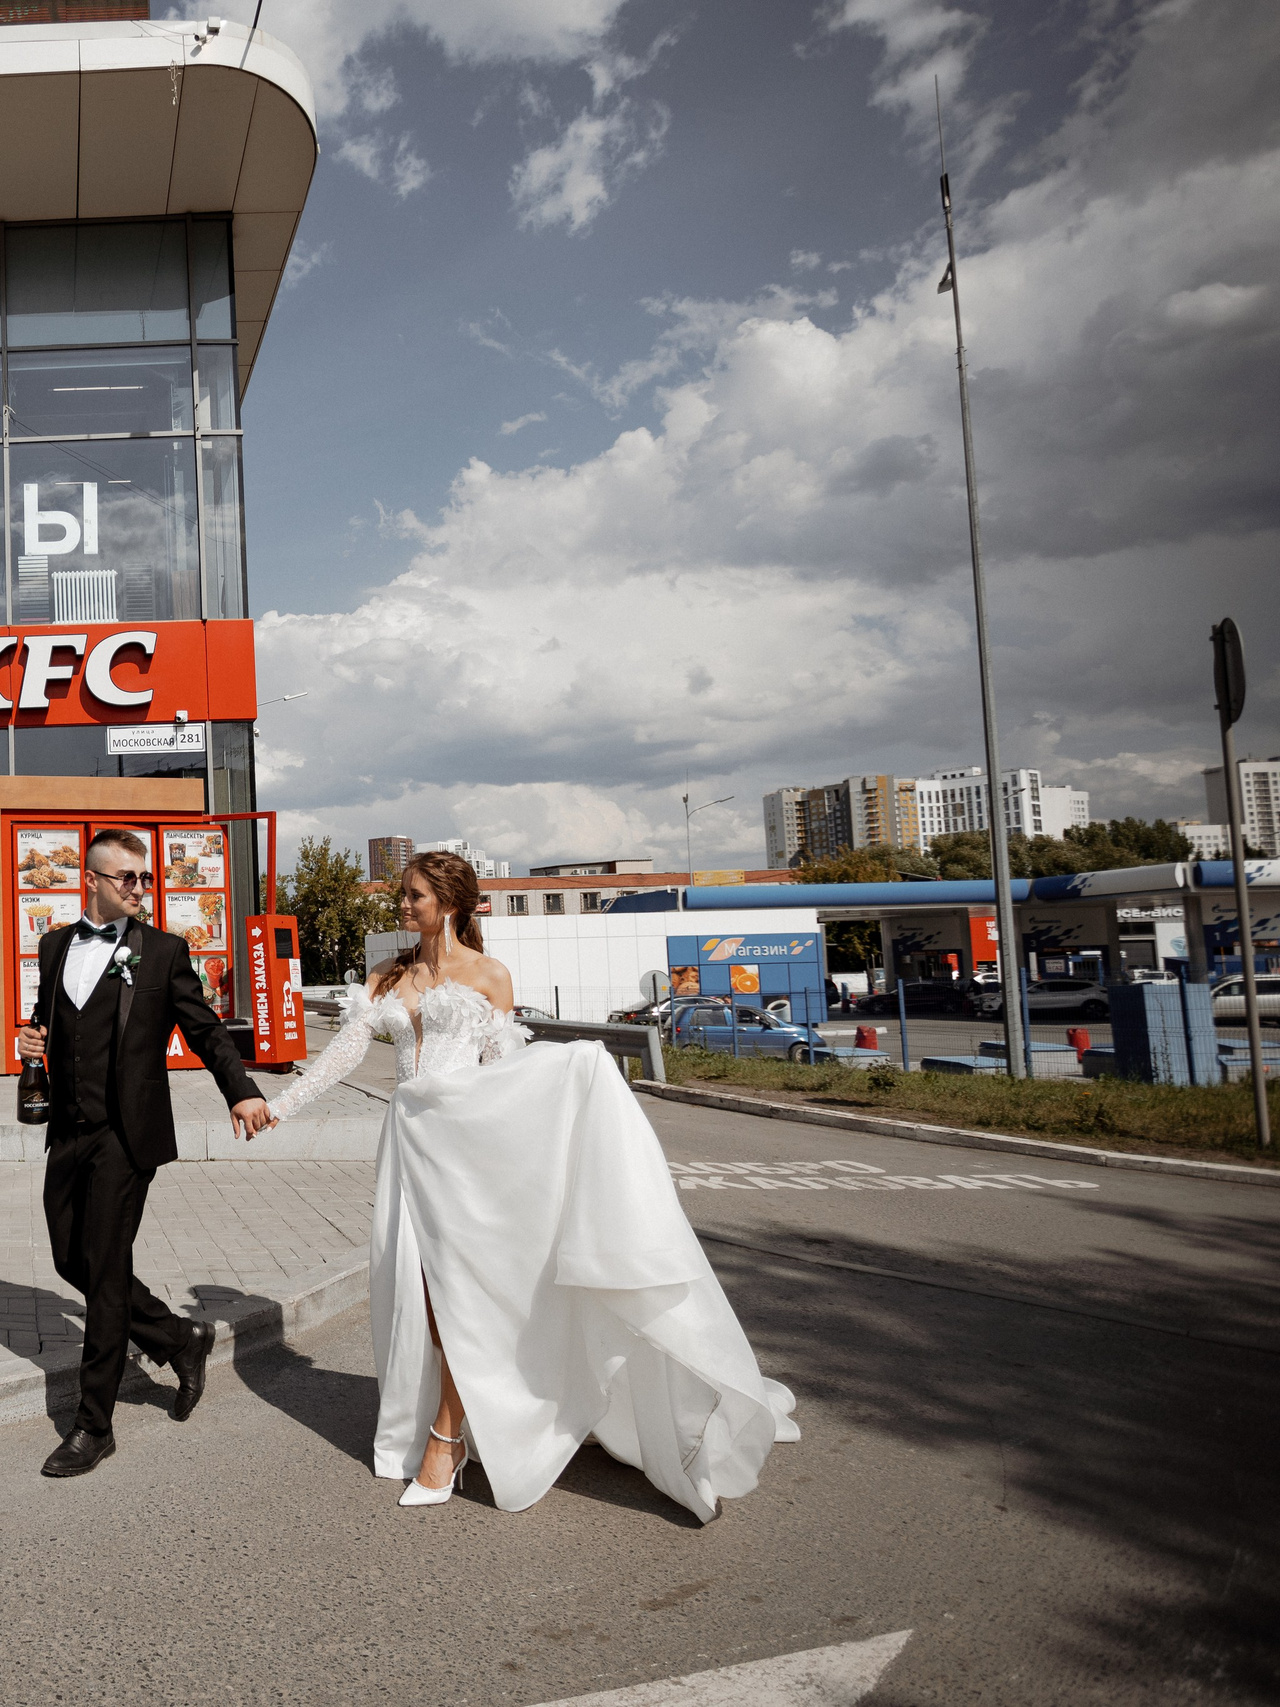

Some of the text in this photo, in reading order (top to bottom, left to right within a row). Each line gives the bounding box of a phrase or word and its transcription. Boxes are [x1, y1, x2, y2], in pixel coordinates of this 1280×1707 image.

[112, 733, 201, 747] МОСКОВСКАЯ 281
[20, 832, 43, 840] КУРИЦА
[724, 943, 788, 956] Магазин
[252, 942, 271, 1036] ПРИЕМ ЗАКАЗА
[284, 1021, 297, 1029] ПРИЕМ
[666, 1161, 886, 1175] ДОБРО
[672, 1175, 1100, 1192] ЖАЛОВАТЬ
